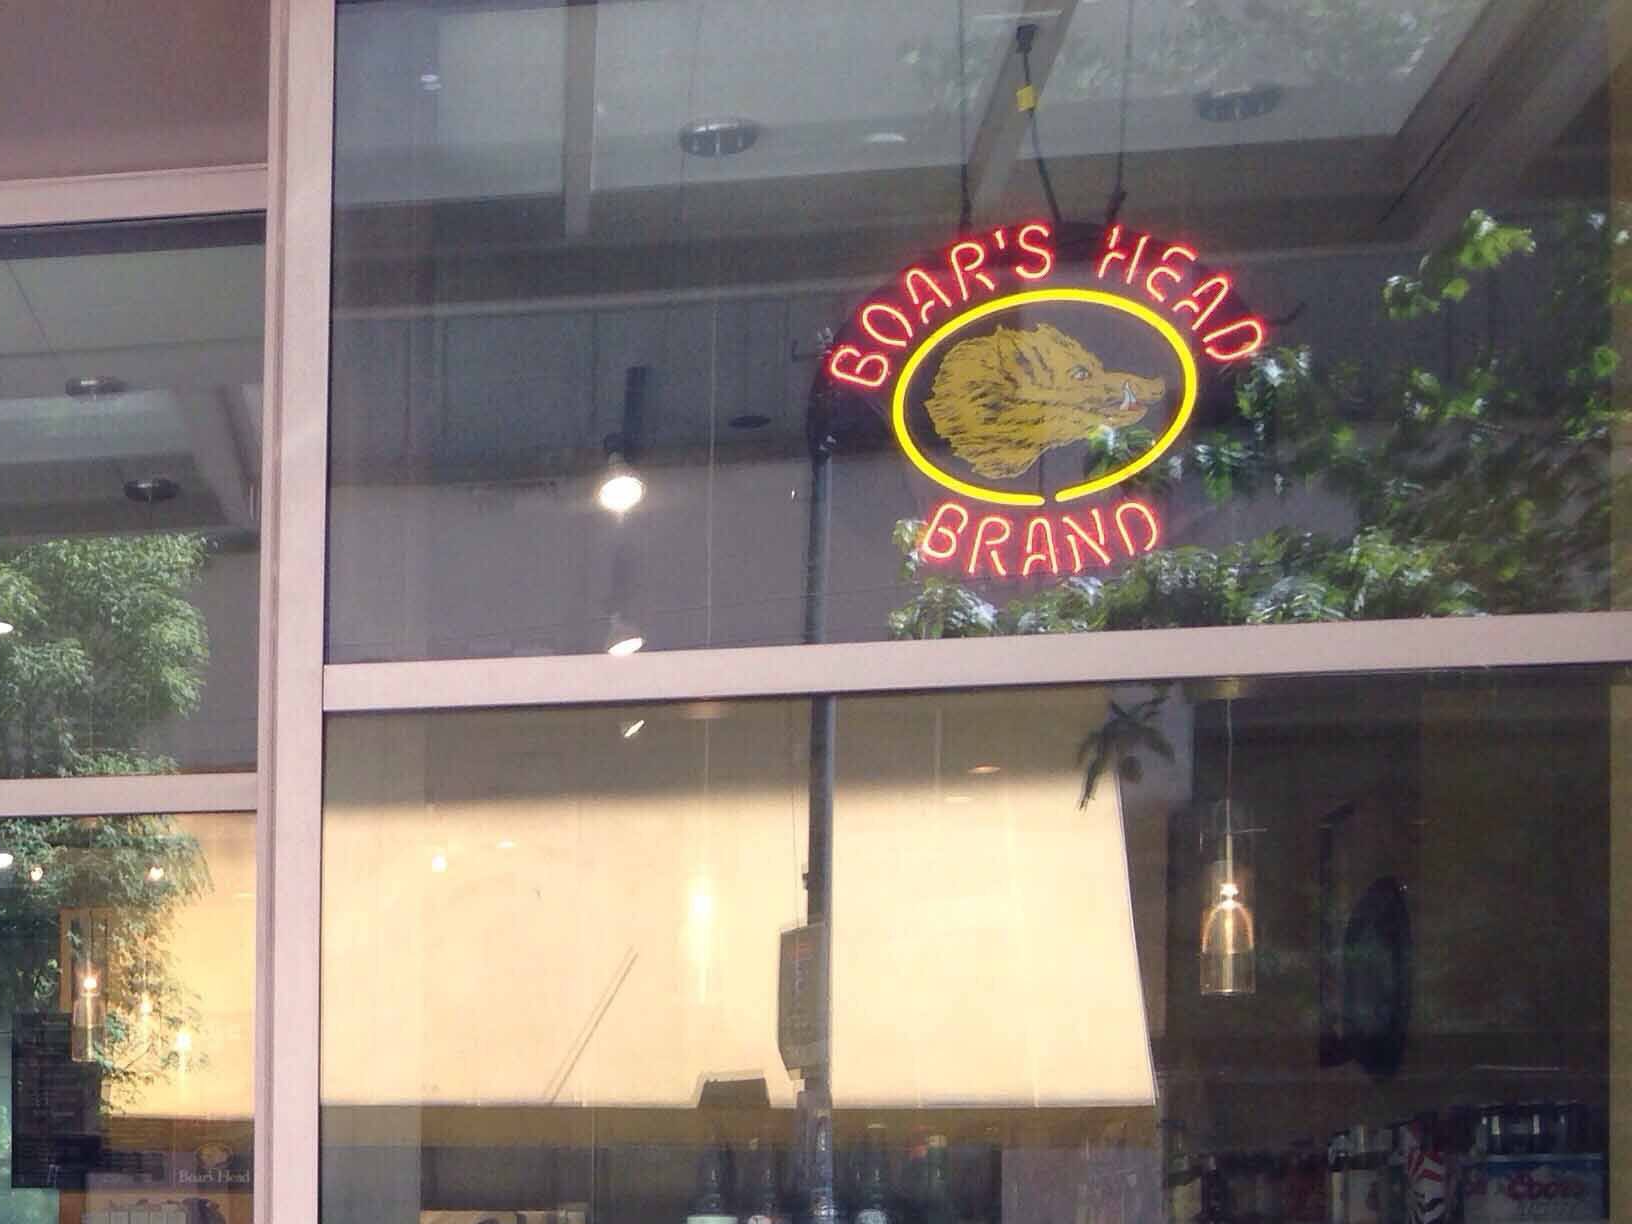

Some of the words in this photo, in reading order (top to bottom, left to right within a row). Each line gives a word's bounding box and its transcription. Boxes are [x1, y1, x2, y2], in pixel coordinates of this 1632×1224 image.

[829, 223, 1054, 388] BOAR'S
[1097, 224, 1264, 361] HEAD
[922, 502, 1159, 577] BRAND
